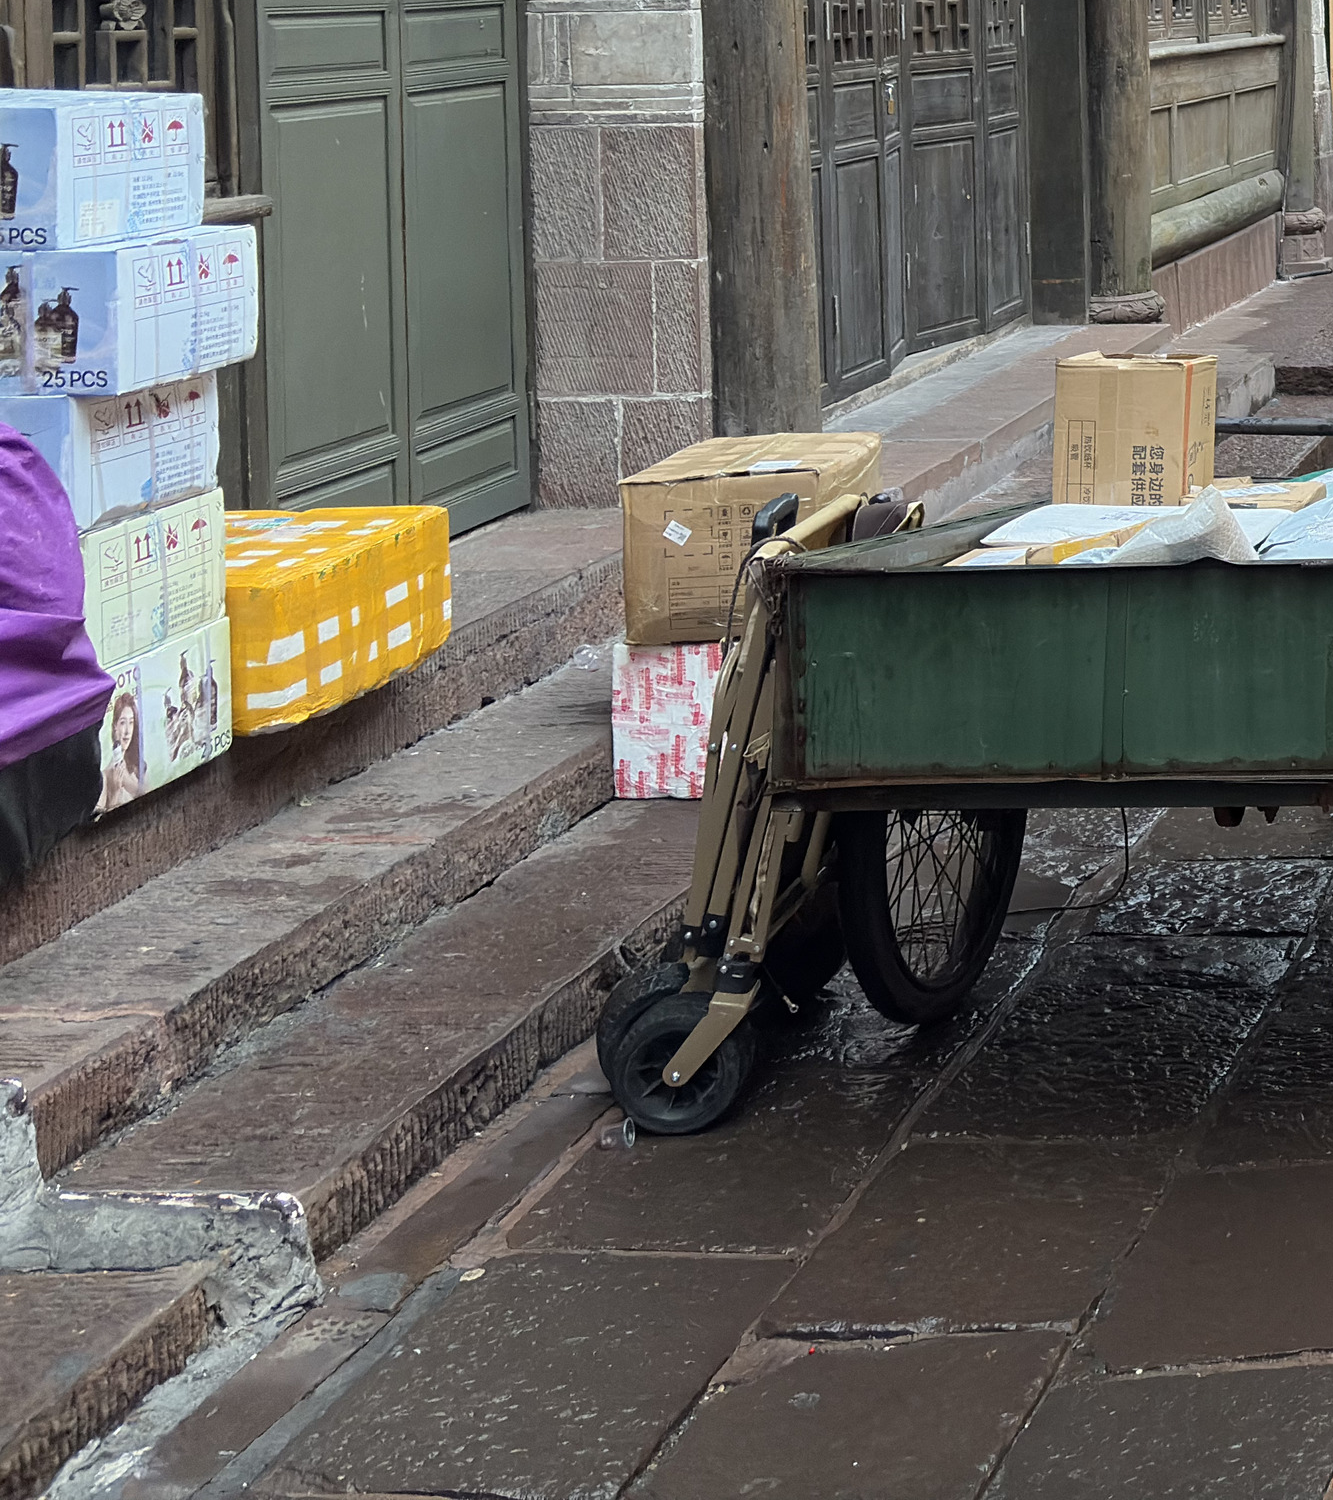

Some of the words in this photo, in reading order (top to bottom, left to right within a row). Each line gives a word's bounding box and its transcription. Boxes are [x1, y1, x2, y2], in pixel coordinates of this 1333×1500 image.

[8, 227, 48, 245] PCS
[42, 370, 67, 388] 25
[69, 369, 108, 388] PCS
[1131, 445, 1148, 506] 配套供应
[1148, 445, 1165, 506] 您身边的
[211, 729, 232, 753] PCS
